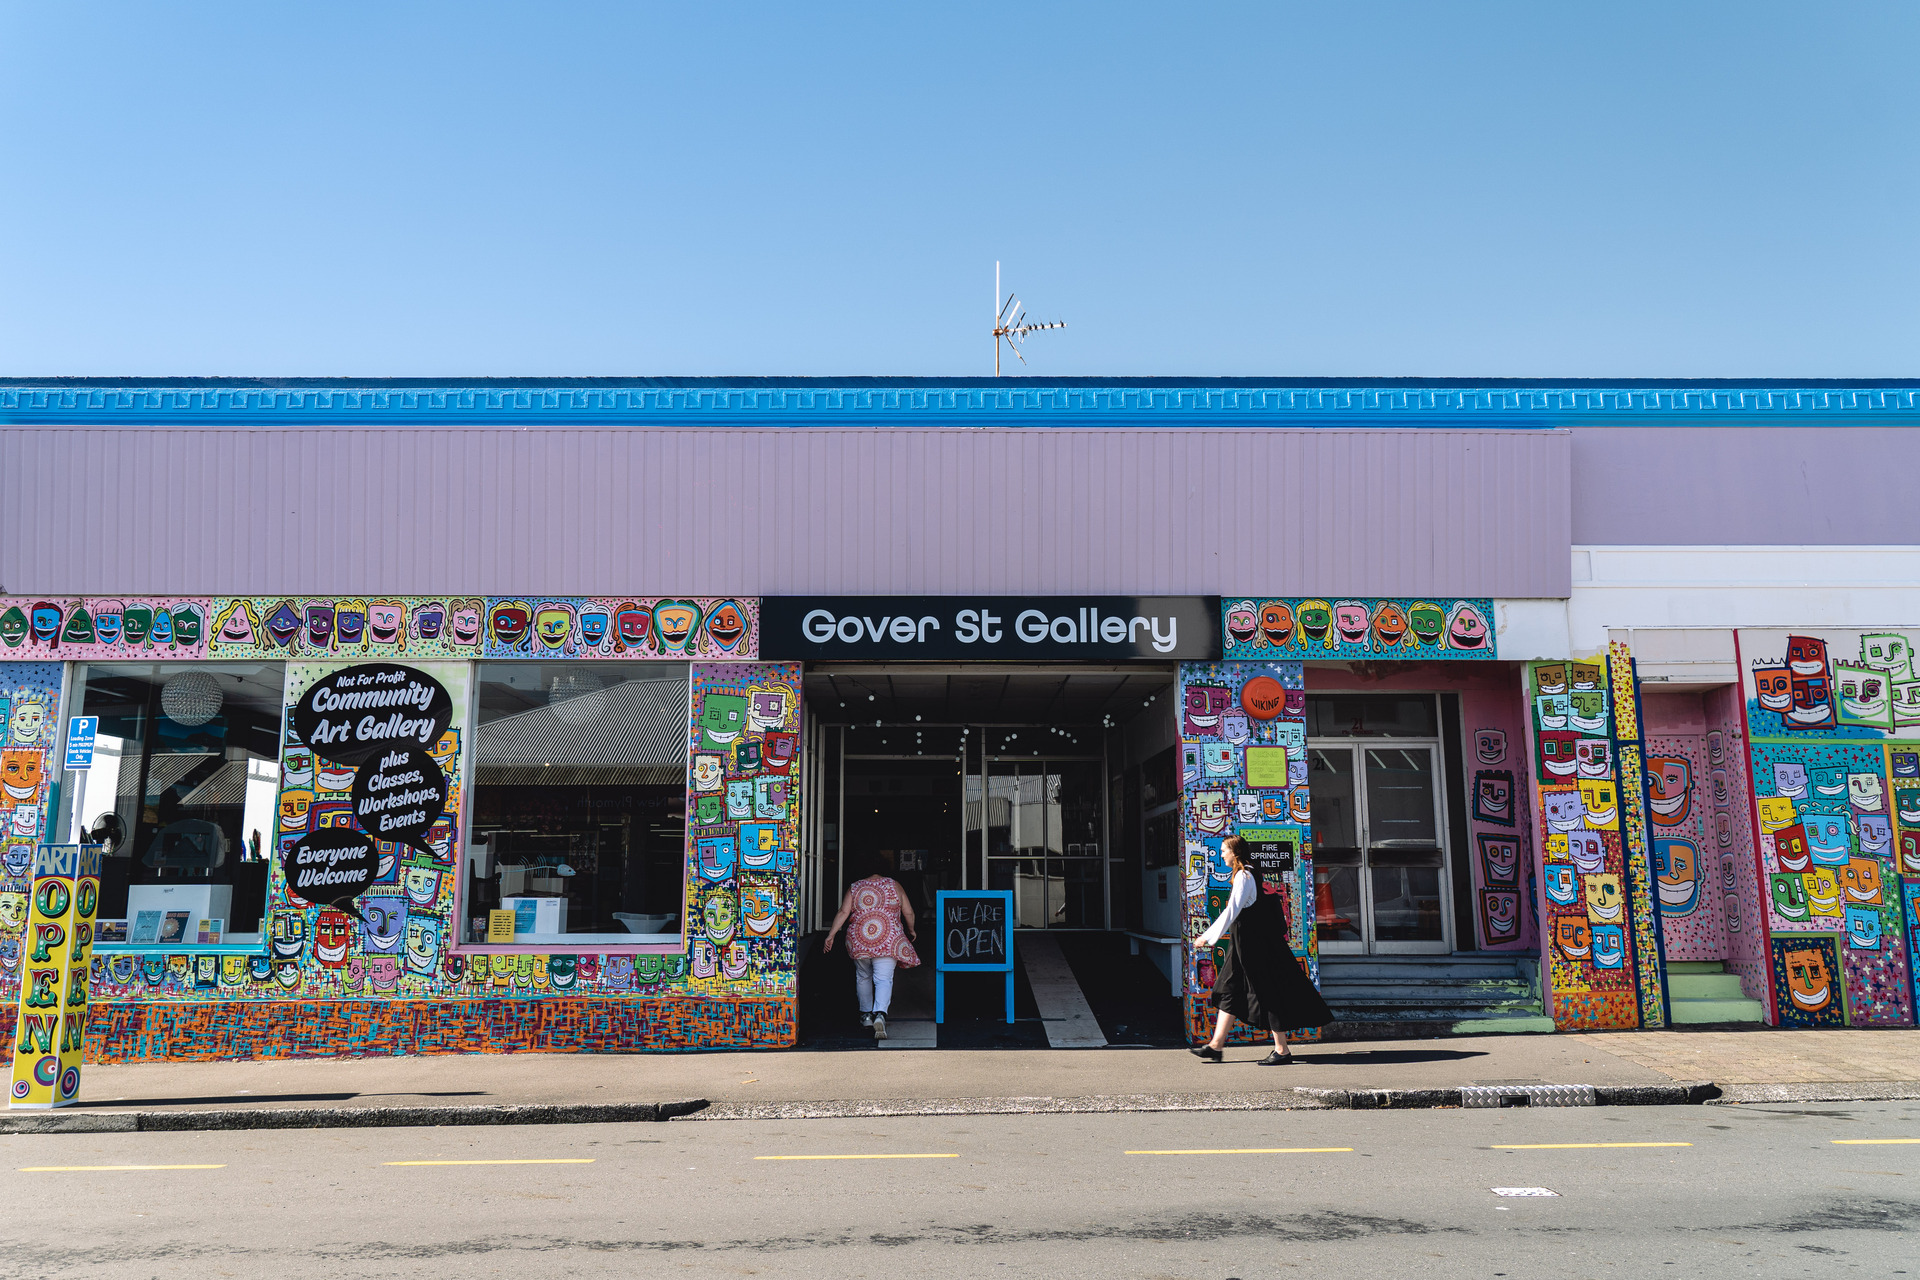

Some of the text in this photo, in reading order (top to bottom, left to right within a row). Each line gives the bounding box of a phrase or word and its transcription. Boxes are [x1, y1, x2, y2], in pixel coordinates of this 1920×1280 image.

[801, 607, 1178, 653] Gover St Gallery
[336, 670, 406, 688] Not For Profit
[312, 681, 435, 712] Community
[1250, 696, 1280, 711] VIKING
[79, 719, 88, 734] P
[310, 712, 436, 744] Art Gallery
[1351, 717, 1364, 730] 21
[379, 750, 410, 772] plus
[1312, 757, 1325, 771] 21
[368, 769, 424, 792] Classes,
[358, 787, 440, 815] Workshops,
[379, 809, 426, 831] Events
[296, 845, 368, 866] Everyone
[1250, 852, 1290, 860] SPRINKLER
[1261, 843, 1278, 851] FIRE
[35, 847, 78, 875] ART
[79, 847, 102, 875] ART
[1260, 860, 1281, 868] INLET
[297, 867, 368, 887] Welcome
[947, 901, 1003, 924] WE ARE
[946, 925, 1004, 958] OPEN
[18, 878, 70, 1055] OPEN
[61, 878, 96, 1053] OPEN
